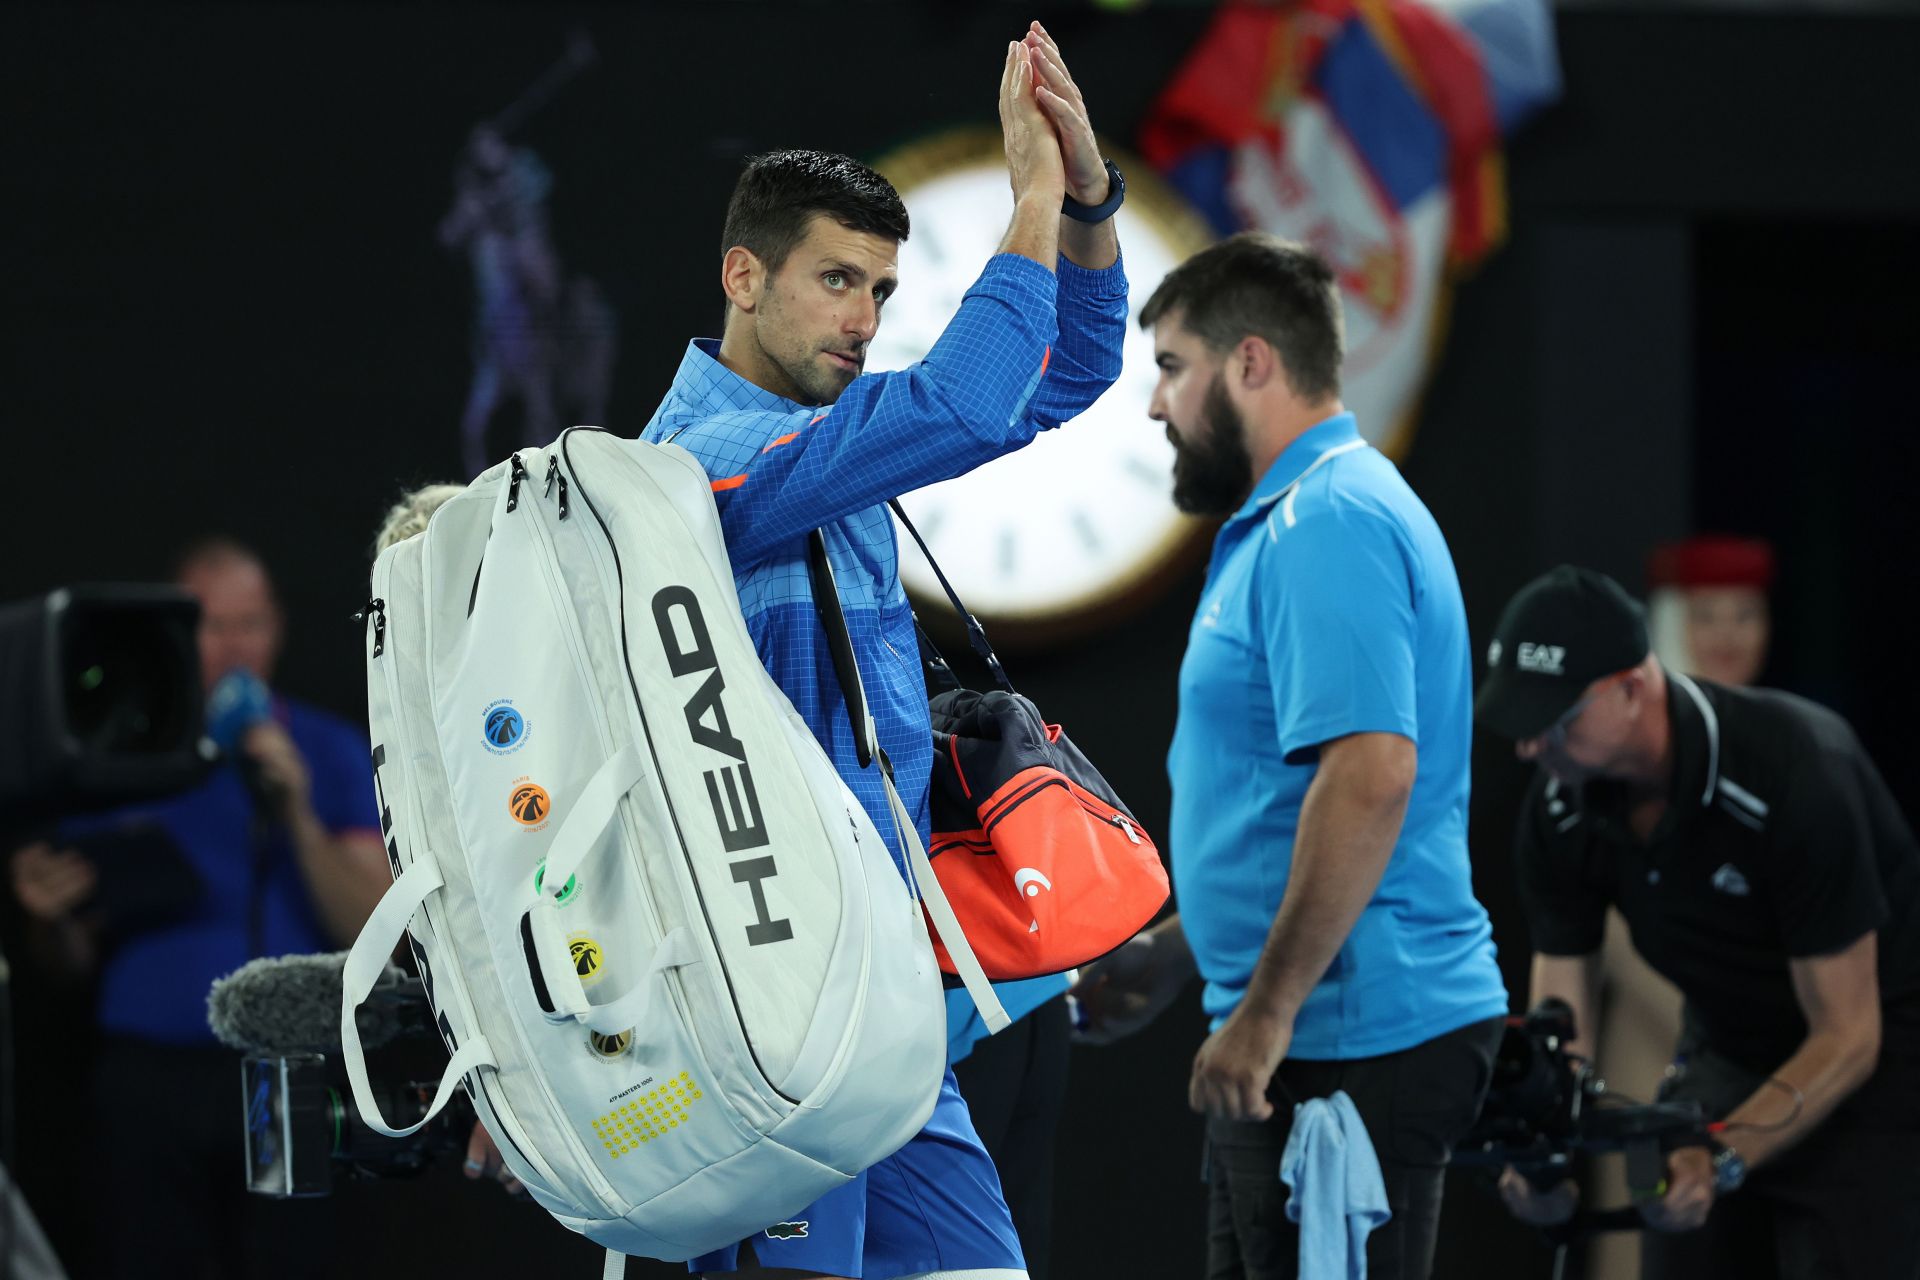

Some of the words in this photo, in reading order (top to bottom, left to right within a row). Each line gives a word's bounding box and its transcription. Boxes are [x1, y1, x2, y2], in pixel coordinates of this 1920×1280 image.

[482, 699, 513, 716] MELBOURNE
[651, 585, 794, 946] HEAD
[609, 1095, 618, 1103] ATP
[618, 1083, 641, 1098] MASTERS
[641, 1077, 653, 1087] 1000
